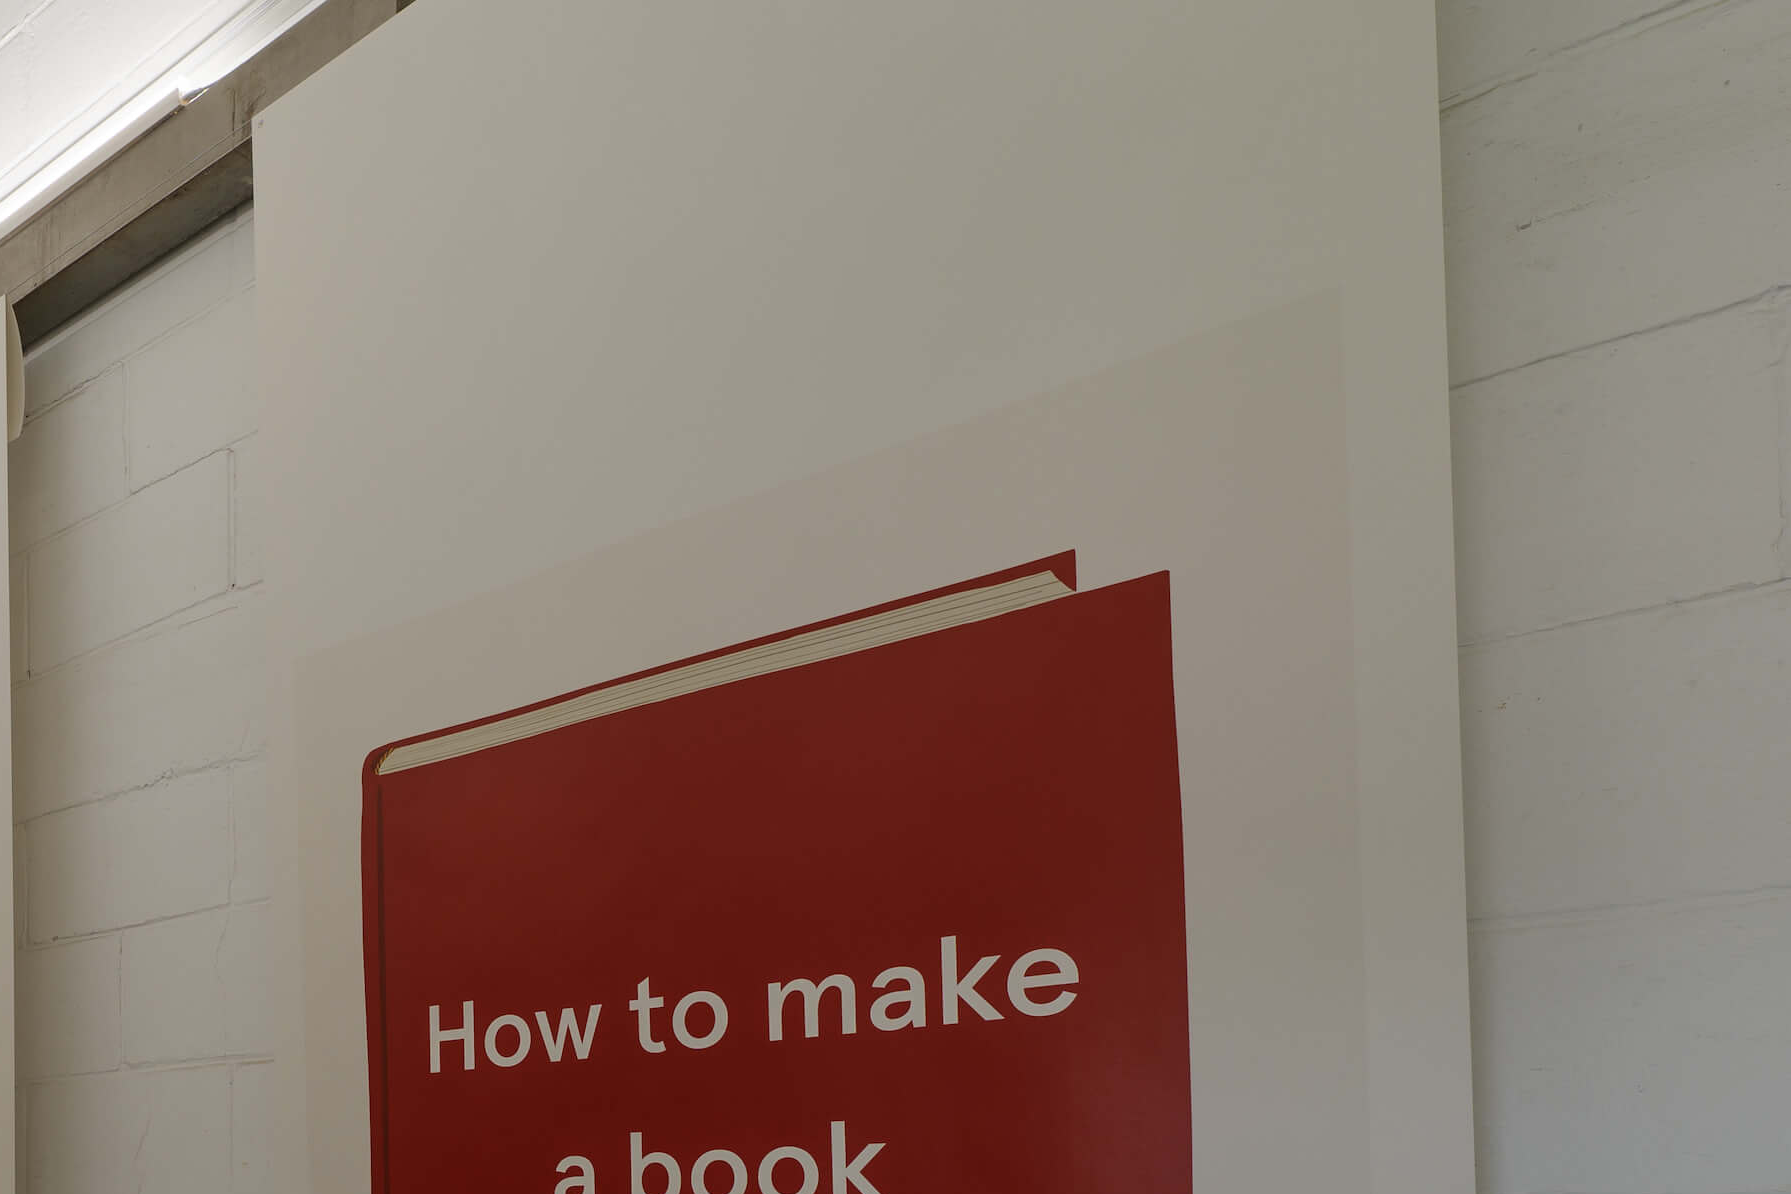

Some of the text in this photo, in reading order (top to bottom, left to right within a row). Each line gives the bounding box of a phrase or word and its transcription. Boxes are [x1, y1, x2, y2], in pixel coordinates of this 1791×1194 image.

[428, 935, 1080, 1074] How to make
